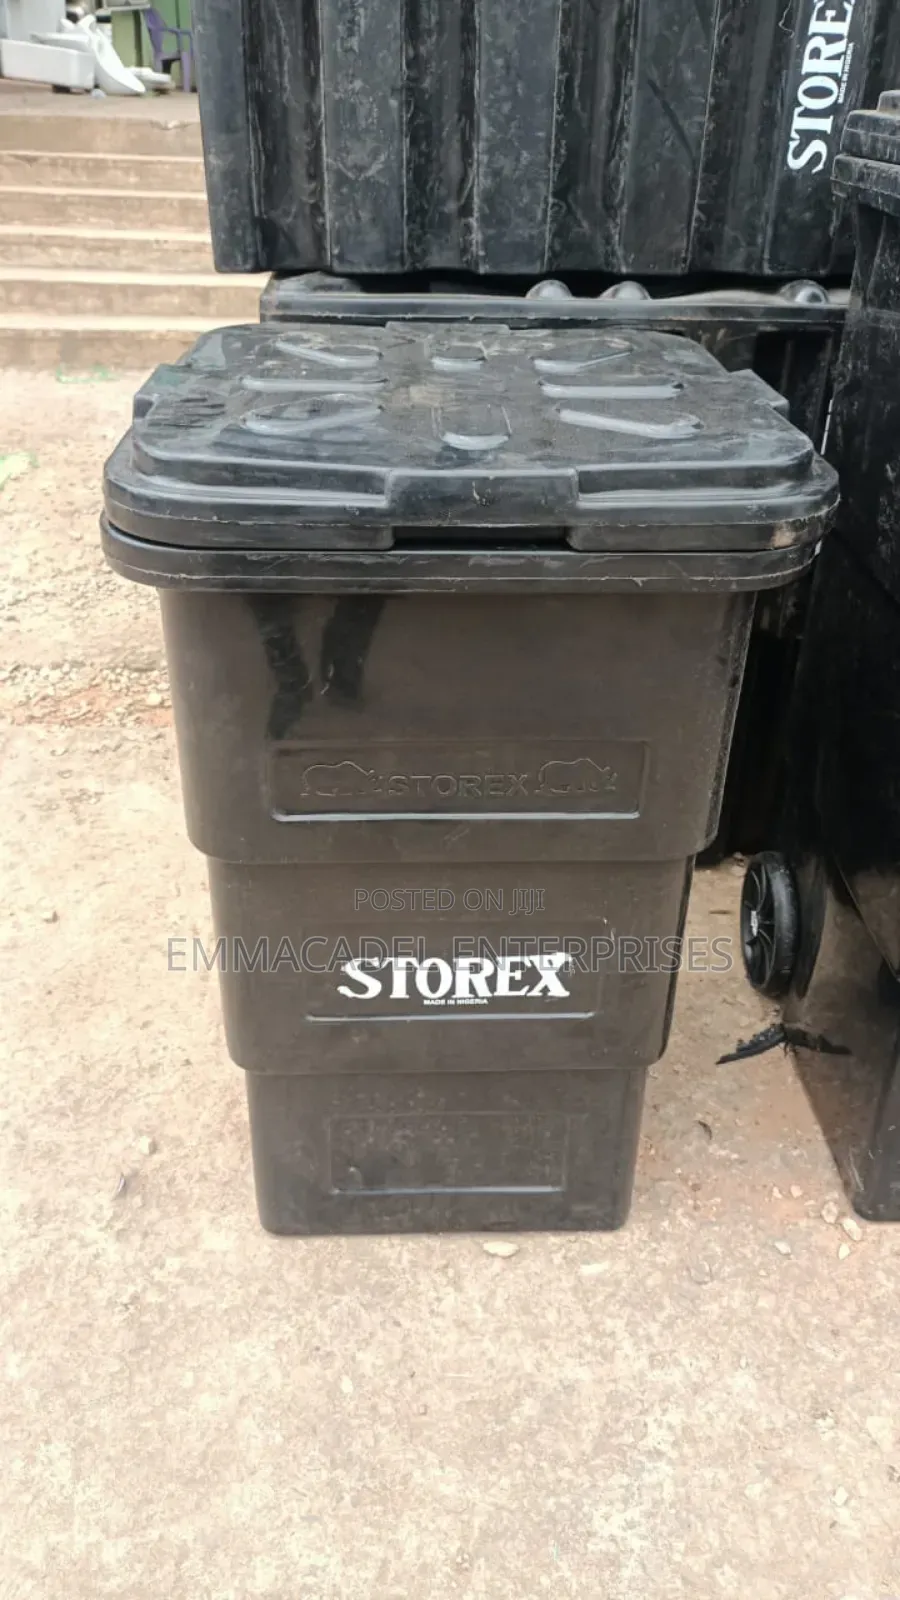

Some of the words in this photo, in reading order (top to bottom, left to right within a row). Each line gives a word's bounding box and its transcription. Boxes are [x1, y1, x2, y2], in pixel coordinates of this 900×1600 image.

[787, 0, 855, 174] STORE
[388, 774, 529, 798] STOREX
[337, 952, 573, 999] STOREX
